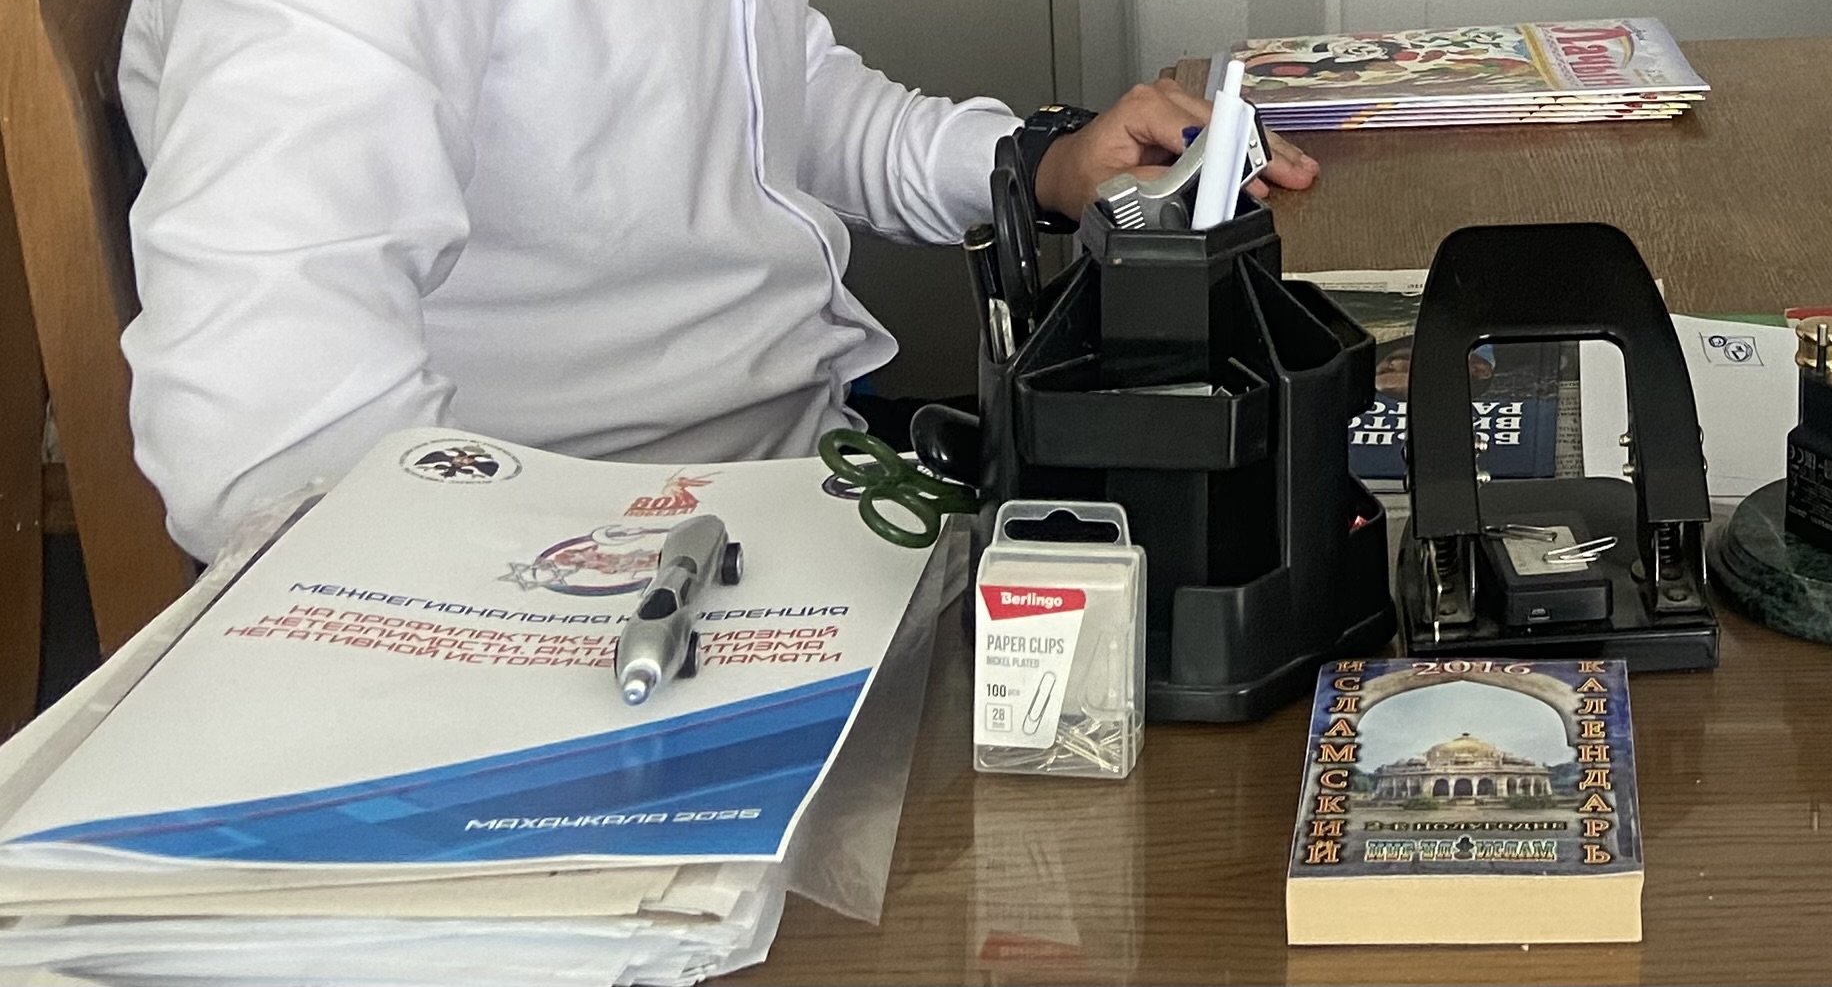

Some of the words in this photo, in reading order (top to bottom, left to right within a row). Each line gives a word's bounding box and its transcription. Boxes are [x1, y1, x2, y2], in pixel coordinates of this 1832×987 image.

[289, 582, 610, 624] МЕЖРЕГИОНАЛЬНАЯ
[615, 606, 850, 624] КЕРЕНЦИЯ
[1001, 591, 1063, 609] Berlingo
[288, 604, 335, 618] НА
[338, 611, 602, 645] ПРОФИЛАКТИКУ
[223, 626, 438, 658] НЕГАТИВНОЙ
[447, 651, 615, 668] ИСТОРИЧЕ
[703, 652, 843, 666] ПАМЯТИ
[986, 634, 1026, 653] PAPER
[1029, 637, 1064, 654] CLIPS
[986, 655, 1011, 667] NICKEL
[1012, 658, 1040, 669] PLATED
[986, 683, 1007, 697] 100
[992, 708, 1005, 721] 28
[1305, 661, 1366, 864] ИСЛАМСКИЙ
[1576, 661, 1613, 864] КАЛЕНДАРЬ
[465, 812, 667, 831] МАХАЧКАЛА
[672, 808, 762, 822] 2025
